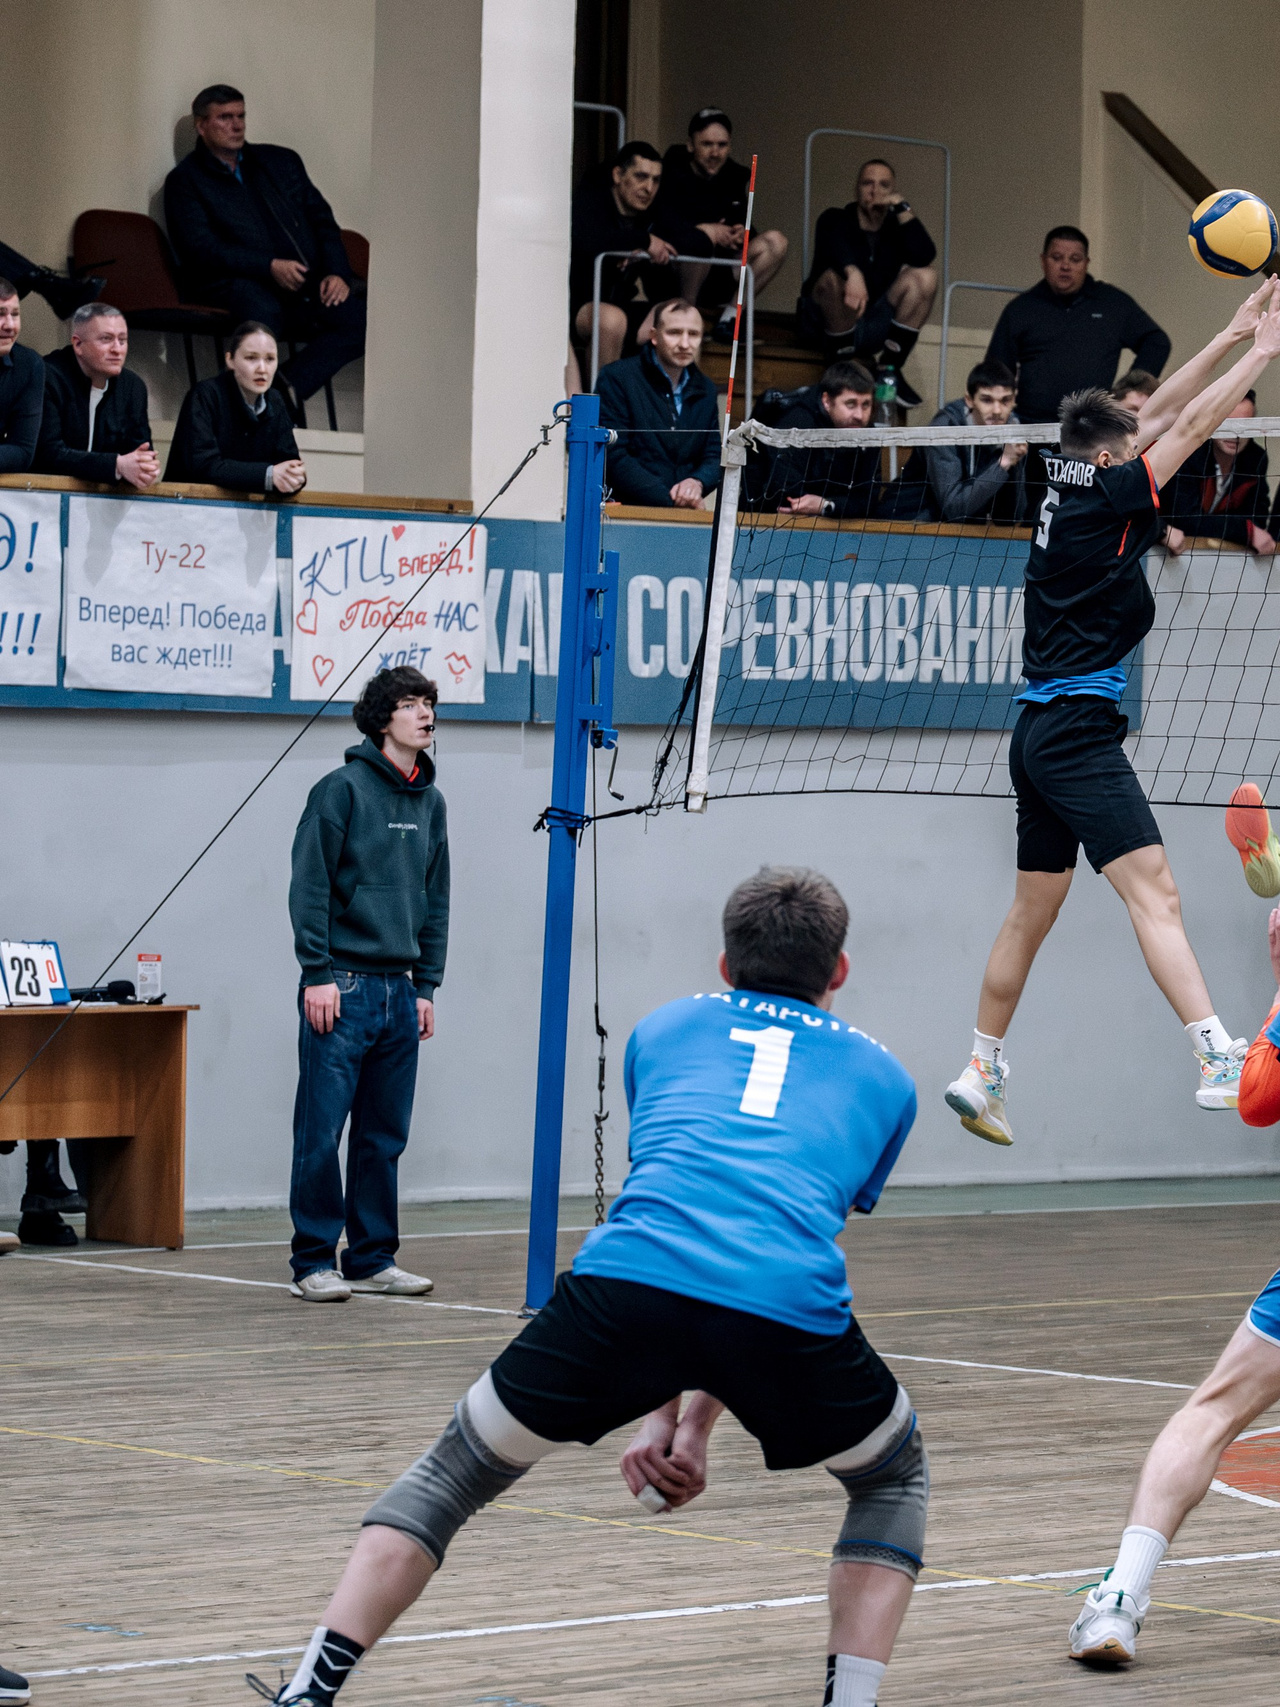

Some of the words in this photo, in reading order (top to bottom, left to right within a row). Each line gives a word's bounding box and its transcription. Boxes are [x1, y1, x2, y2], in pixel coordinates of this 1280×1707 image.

[1035, 486, 1059, 549] 5
[141, 541, 206, 573] Ту-22
[300, 534, 394, 601] КТЦ
[398, 528, 477, 577] ВПЕРЁД!
[78, 596, 170, 631] Вперед!
[180, 602, 266, 635] Победа
[339, 596, 427, 632] Победа
[434, 600, 479, 632] НАС
[111, 643, 148, 664] вас
[156, 643, 232, 670] ждет!!!
[10, 956, 41, 998] 23
[729, 1025, 795, 1119] 1
